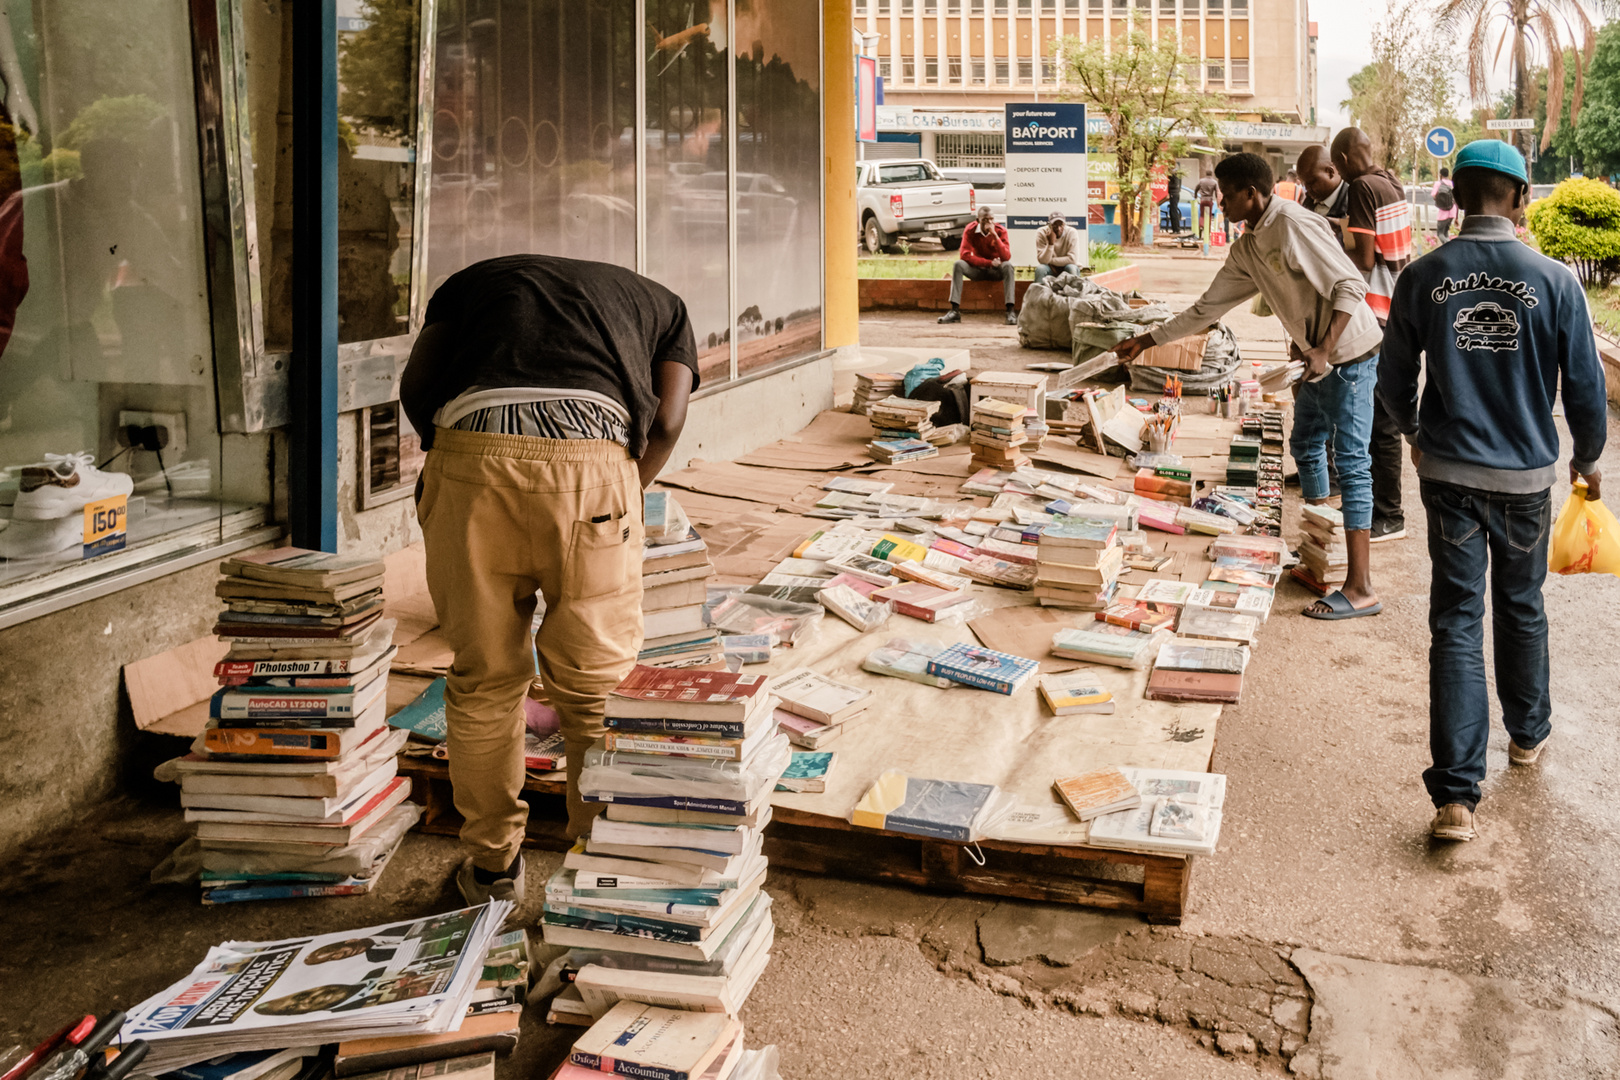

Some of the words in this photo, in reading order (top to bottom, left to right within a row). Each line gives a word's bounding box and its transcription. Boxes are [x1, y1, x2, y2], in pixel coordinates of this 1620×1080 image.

[943, 116, 983, 127] Bureau
[988, 117, 1001, 127] de
[1012, 126, 1077, 138] BAYPORT
[1246, 125, 1276, 138] Change
[1280, 127, 1292, 136] Ltd
[1432, 272, 1539, 308] Authentic
[259, 662, 310, 673] Photoshop
[313, 662, 319, 671] 7
[941, 667, 954, 676] BUSY
[954, 671, 976, 682] PEOPLE'S
[976, 676, 996, 687] LOW-FAT
[772, 671, 812, 690] ADMINISTRATION
[249, 700, 287, 709] AutoCAD
[195, 996, 234, 1020] MEDIA
[229, 960, 270, 993] MOGULS
[210, 1000, 247, 1024] TAKE
[253, 951, 293, 988] POLITICS
[634, 1013, 682, 1056] Accounting
[572, 1054, 600, 1067] Oxford
[617, 1062, 670, 1080] Accounting
